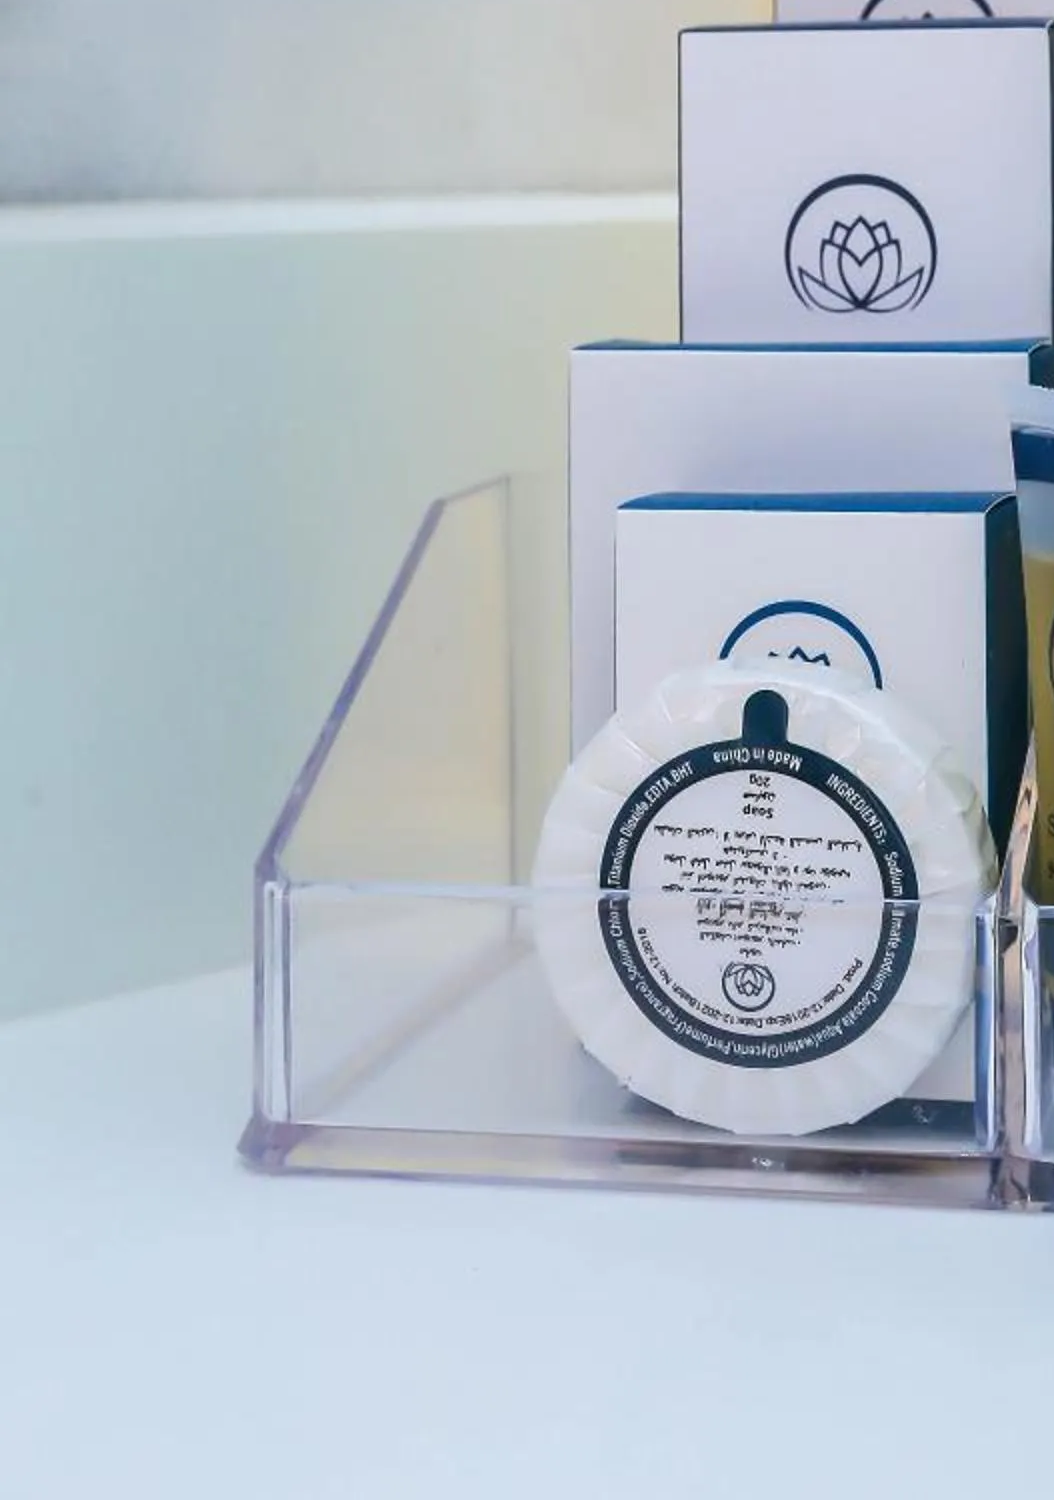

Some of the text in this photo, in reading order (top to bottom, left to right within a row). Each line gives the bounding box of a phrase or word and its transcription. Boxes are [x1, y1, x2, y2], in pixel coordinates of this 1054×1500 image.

[712, 748, 803, 771] Made in China
[750, 775, 771, 787] 20g
[743, 804, 774, 819] Soap
[827, 774, 887, 844] INGREDIENTS:
[884, 851, 905, 897] Sodium
